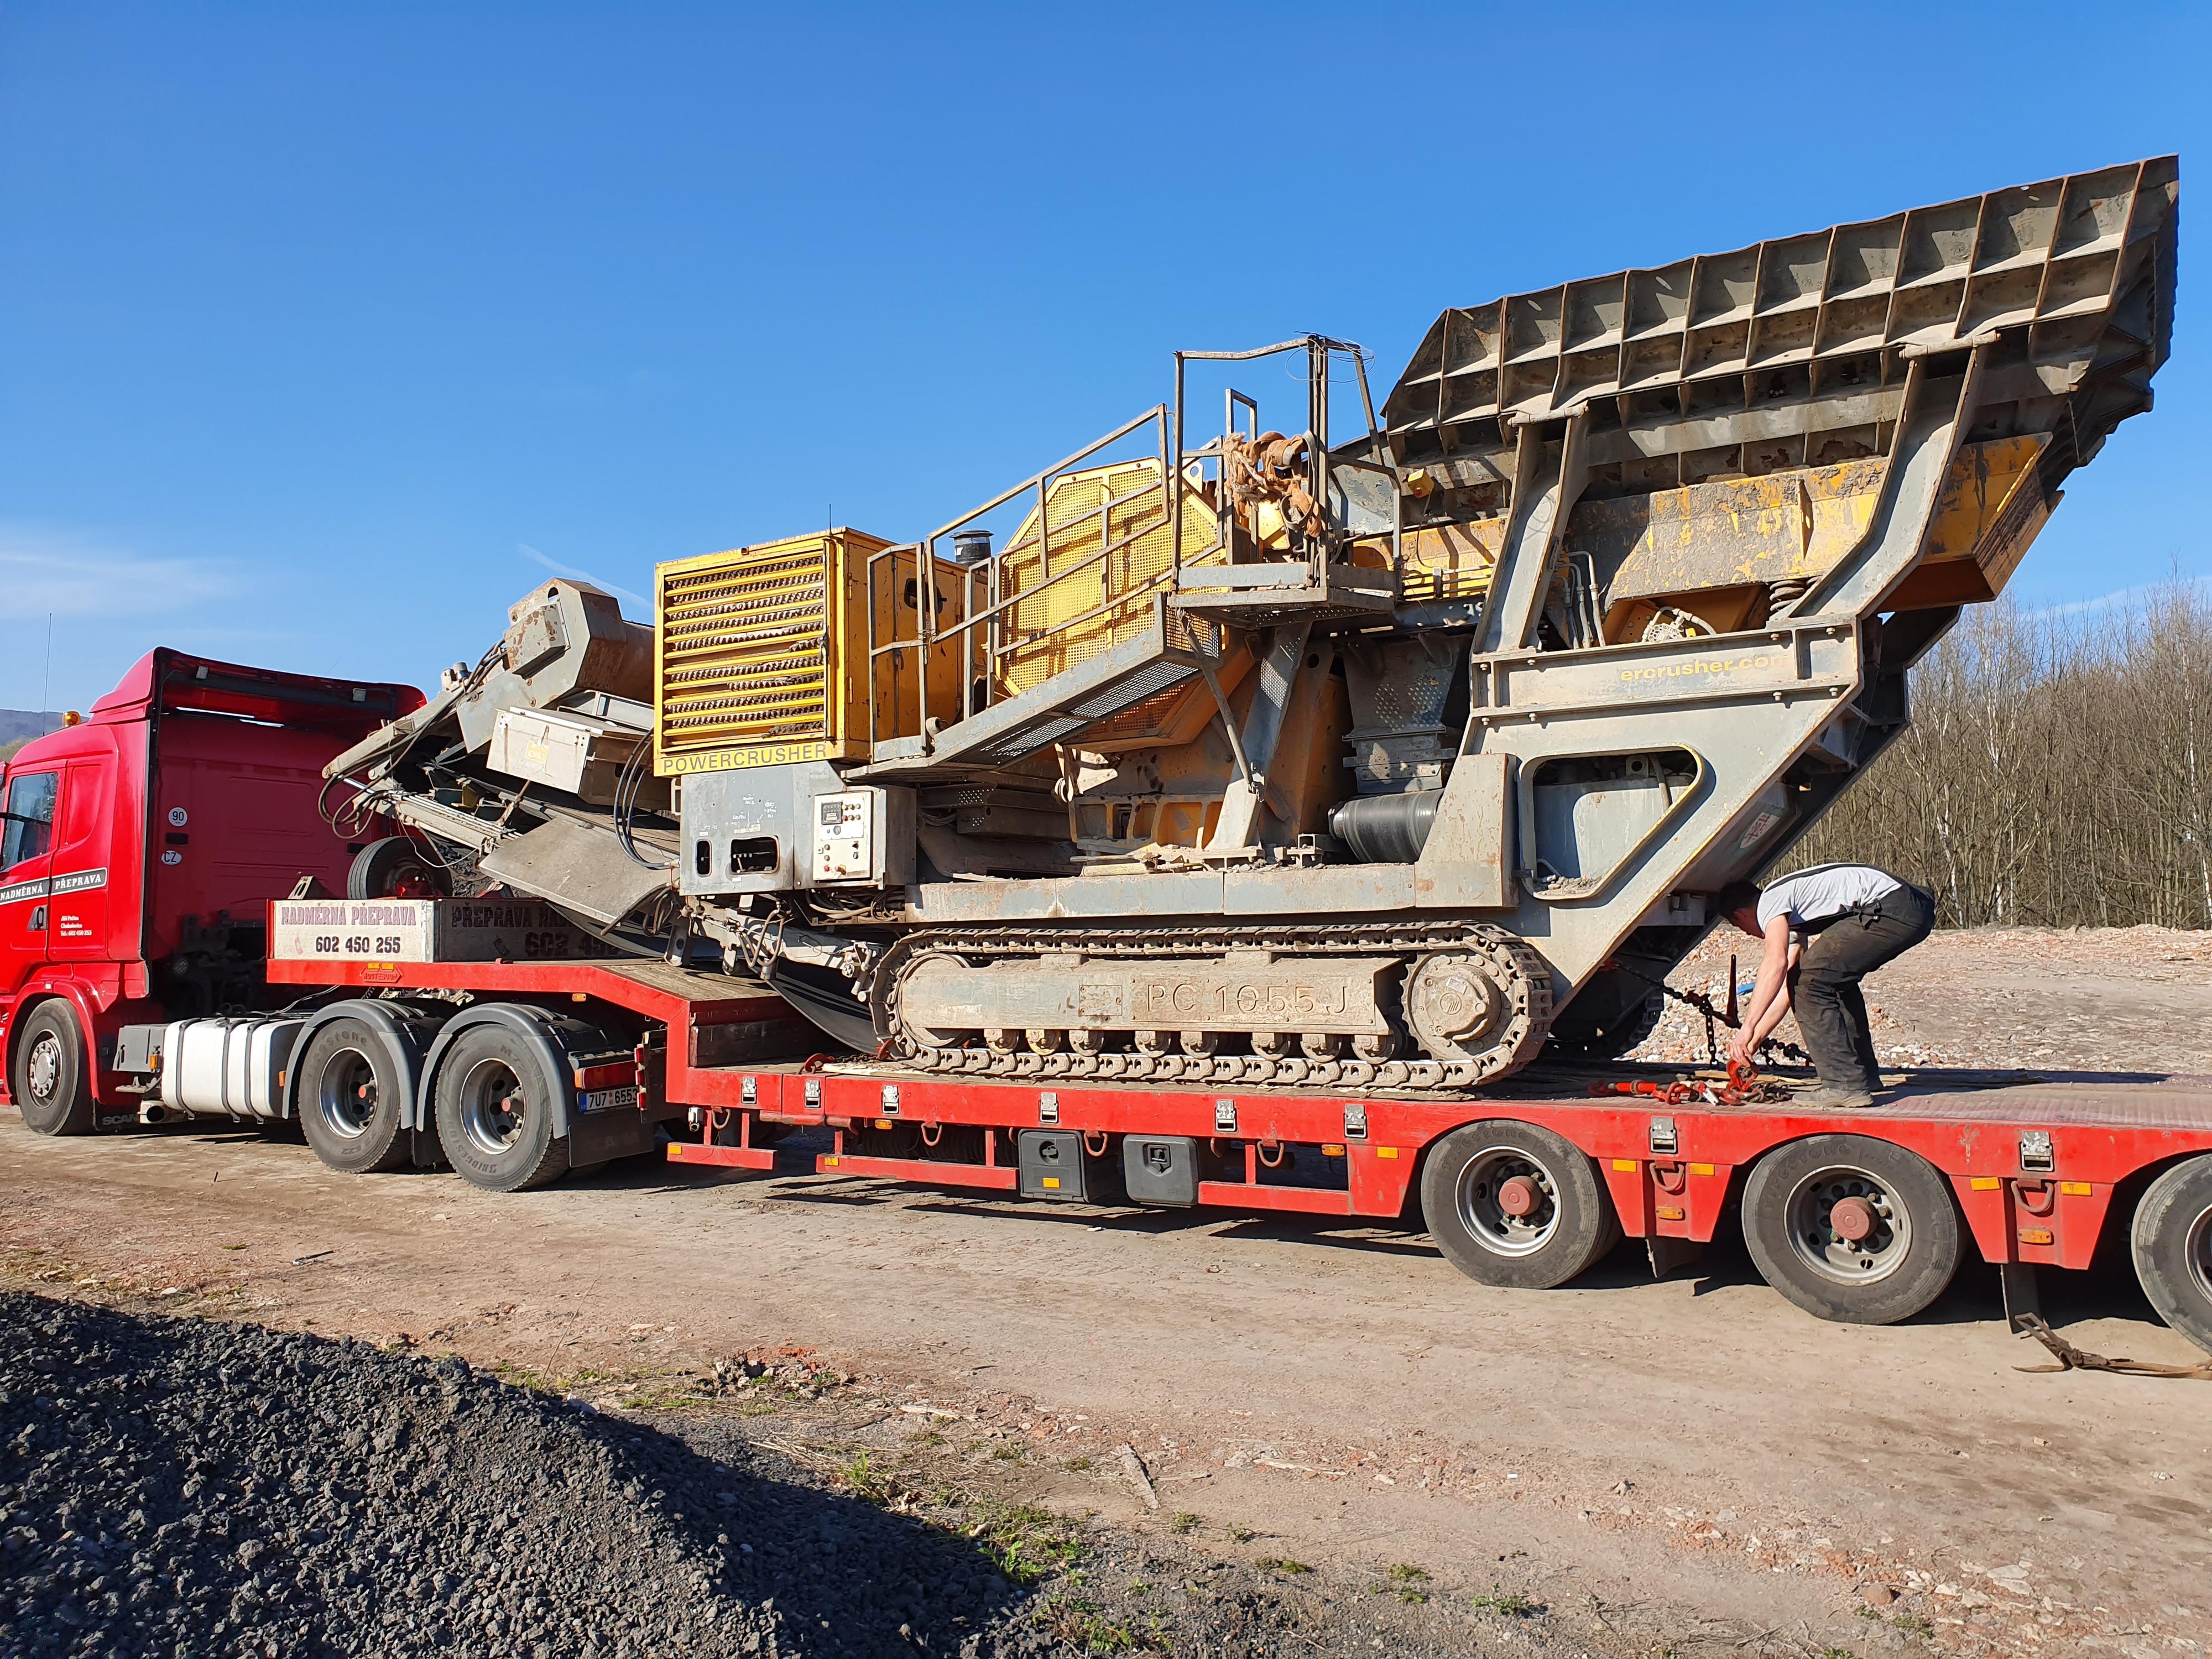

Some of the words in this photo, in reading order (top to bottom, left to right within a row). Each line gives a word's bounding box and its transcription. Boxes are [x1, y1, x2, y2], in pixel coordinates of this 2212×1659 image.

[664, 743, 826, 773] POWERCRUSHER
[173, 811, 184, 821] 90
[164, 852, 176, 862] CZ
[0, 883, 43, 901] NADMĚRNÁ
[55, 874, 101, 890] PŘEPRAVA
[281, 903, 346, 925] NADMĚRNÁ
[351, 902, 416, 925] PŘEPRAVA
[316, 936, 339, 952] 602
[345, 936, 369, 952] 450
[376, 936, 400, 953] 255
[525, 931, 568, 957] 602
[1147, 983, 1197, 1013] PC
[588, 1092, 607, 1108] 7U7
[102, 1113, 138, 1126] SCAN
[447, 1120, 497, 1174] BRIDGESTON
